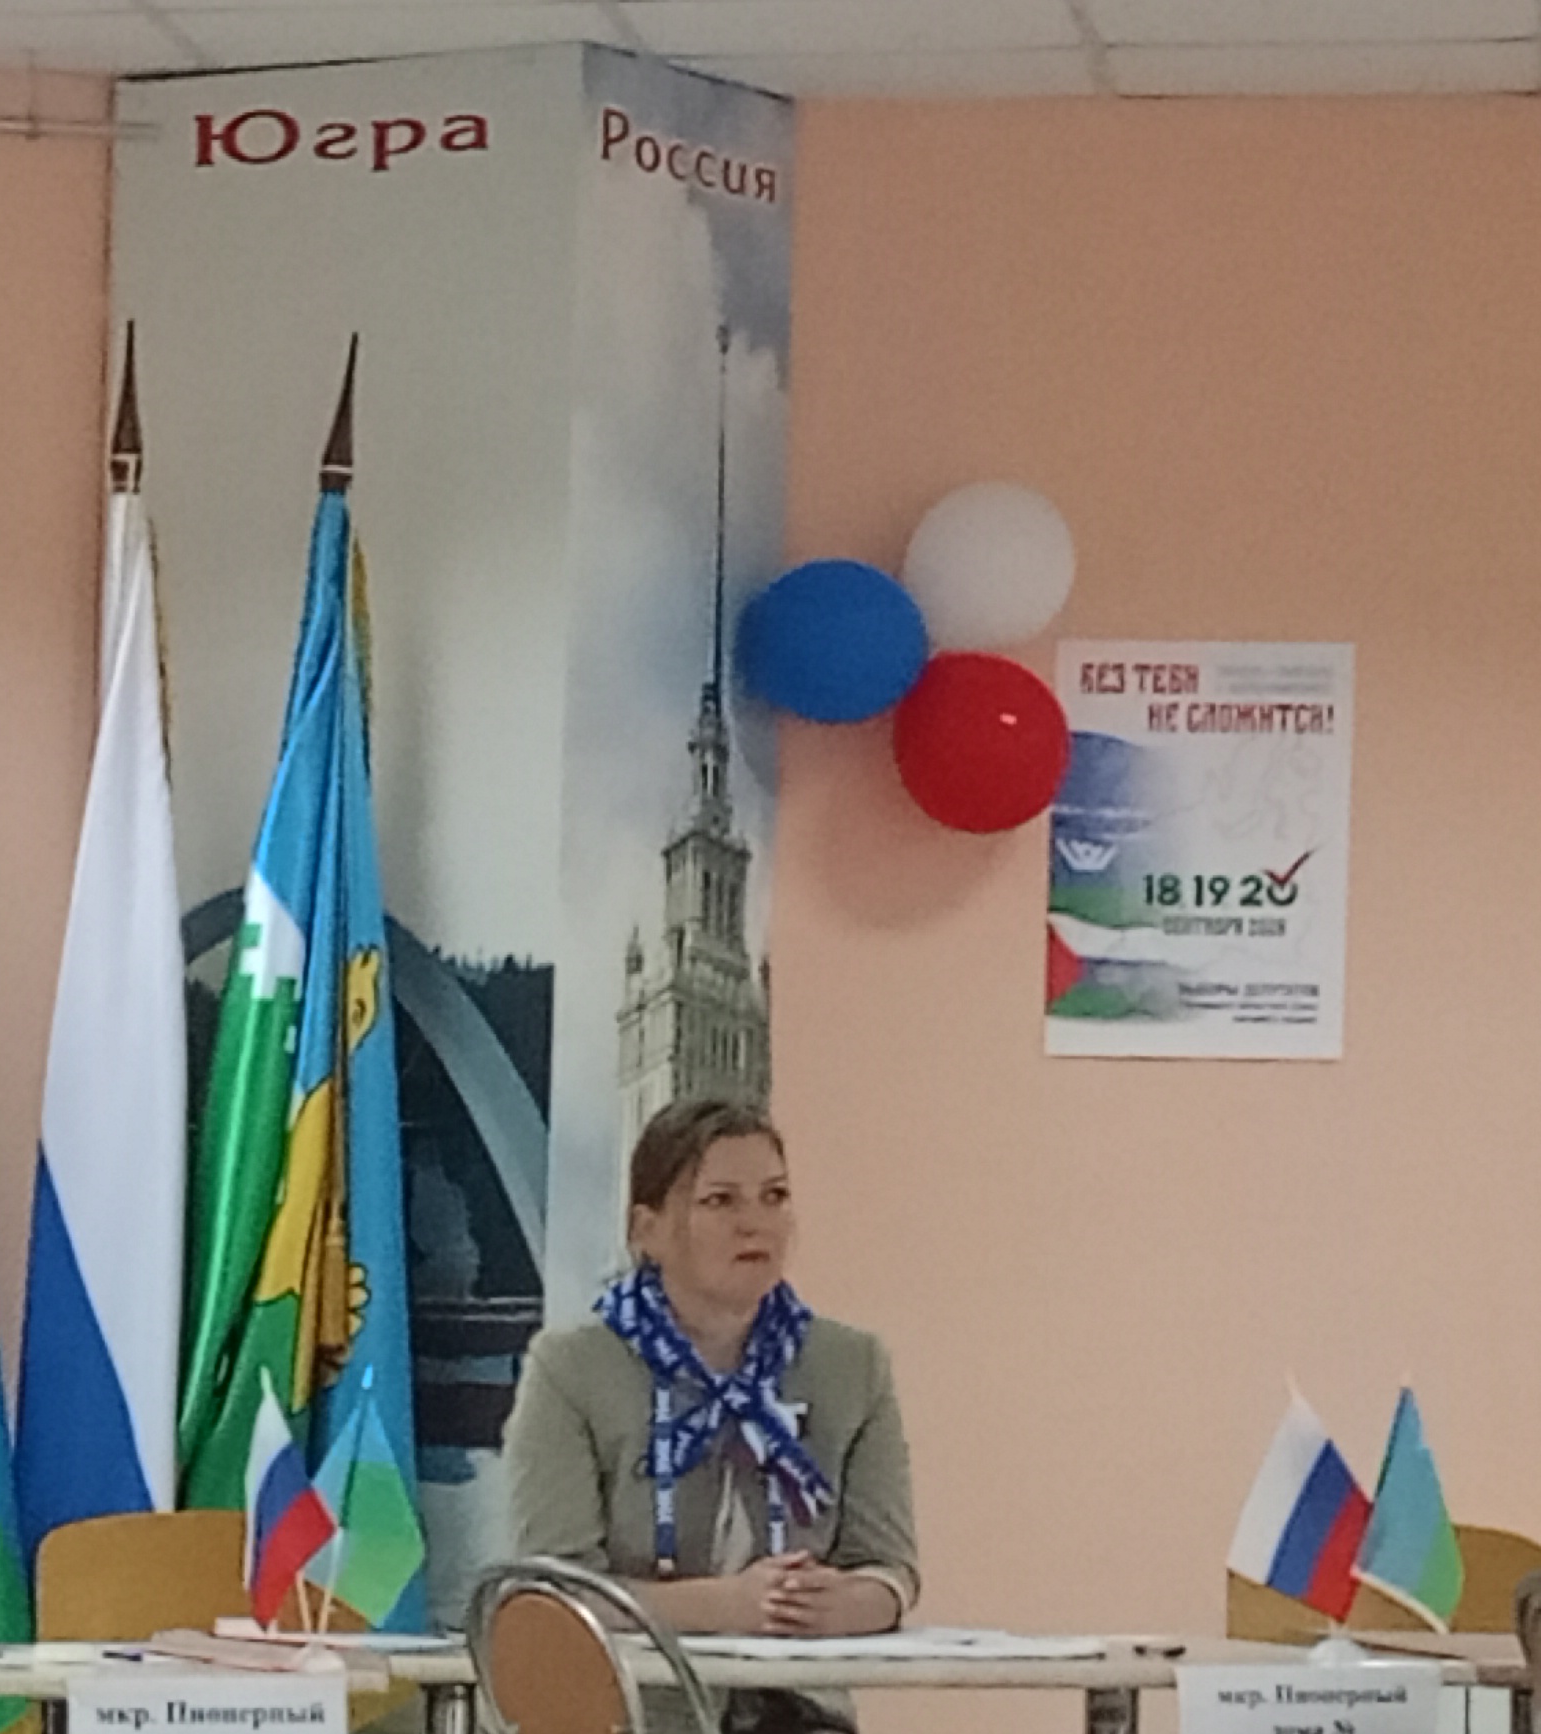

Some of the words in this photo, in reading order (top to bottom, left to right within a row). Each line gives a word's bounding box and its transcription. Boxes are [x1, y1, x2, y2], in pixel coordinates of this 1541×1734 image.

[194, 109, 489, 171] Югра
[601, 108, 777, 202] Россия
[1080, 663, 1125, 694] БЕЗ
[1132, 664, 1199, 694] ТЕБЯ
[1148, 703, 1179, 732] НЕ
[1186, 703, 1334, 734] СЛОЖИТСЯ!
[1144, 873, 1181, 906] 18
[1193, 874, 1231, 907] 19
[1239, 874, 1298, 907] 20
[1218, 1689, 1267, 1709] мкр.
[1275, 1684, 1407, 1709] Пионерный
[96, 1707, 156, 1730] мкр.
[166, 1701, 325, 1731] Пионерный
